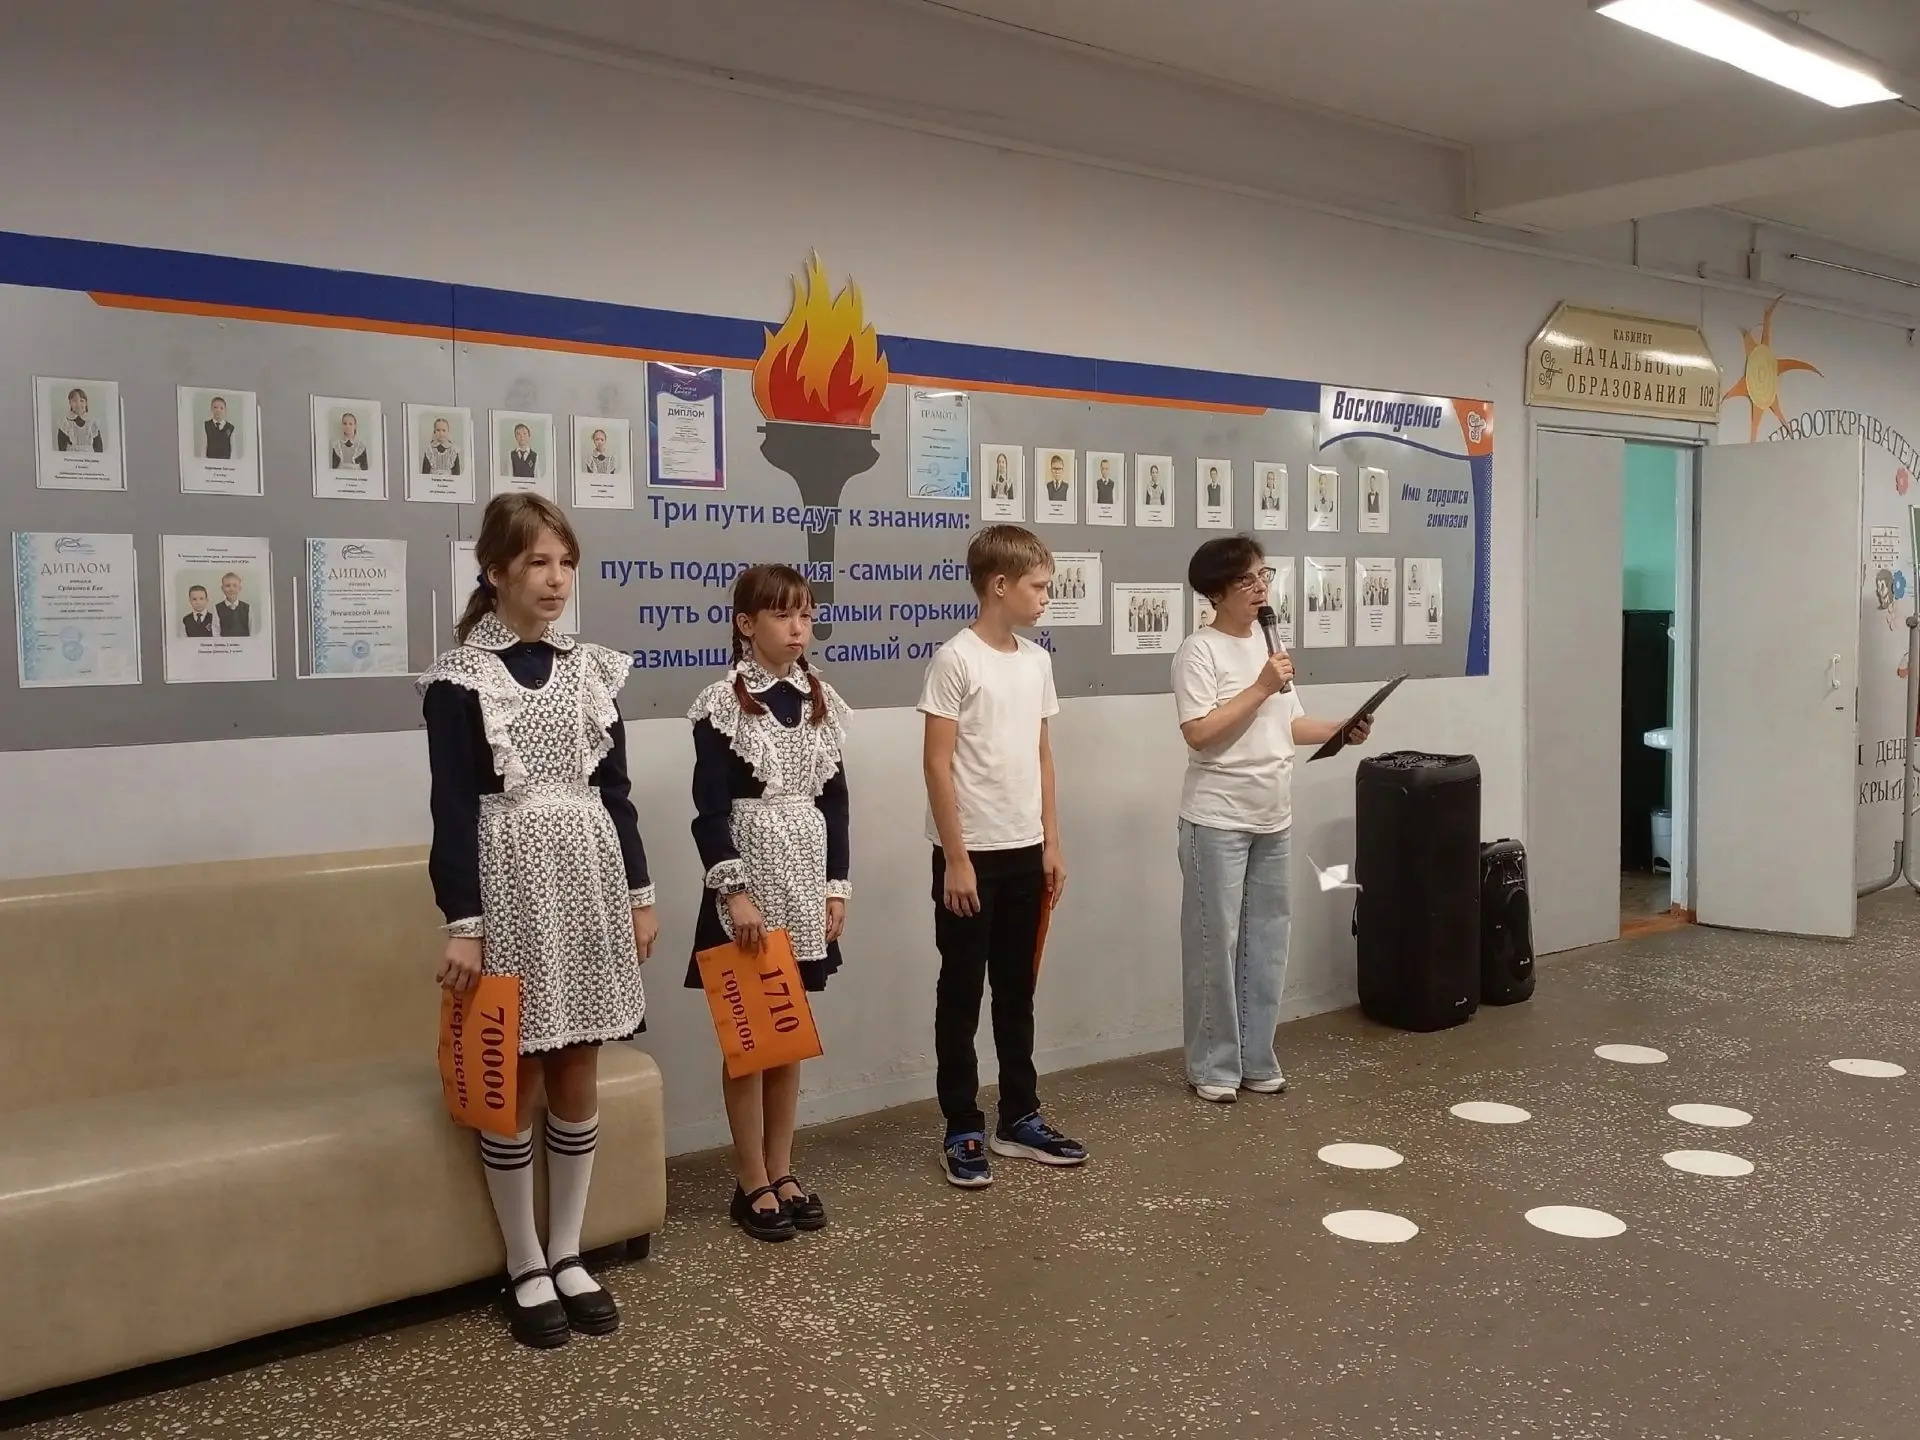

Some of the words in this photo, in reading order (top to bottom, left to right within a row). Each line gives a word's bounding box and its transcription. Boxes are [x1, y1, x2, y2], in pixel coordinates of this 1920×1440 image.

[1613, 328, 1654, 346] КАБИНЕТ
[1567, 373, 1687, 405] ОБРАЗОВАНИЯ
[1699, 386, 1715, 408] 102
[667, 408, 705, 418] ДИПЛОМ
[921, 409, 958, 421] ГРАМОТА
[1333, 391, 1443, 433] Восхождение
[1402, 483, 1421, 502] Ими
[1427, 488, 1469, 508] гордится
[648, 495, 698, 528] Три
[706, 502, 764, 530] пути
[773, 506, 842, 533] ведут
[850, 510, 864, 526] к
[868, 510, 970, 530] знаниям:
[1427, 513, 1469, 529] гимназия
[41, 563, 111, 577] ДИПЛОМ
[328, 567, 387, 581] ДИПЛОМ
[601, 560, 664, 588] путь
[639, 604, 701, 631] путь
[825, 636, 899, 662] самый
[721, 968, 755, 1053] городов
[759, 965, 800, 1034] 1710
[480, 1006, 506, 1110] 70000
